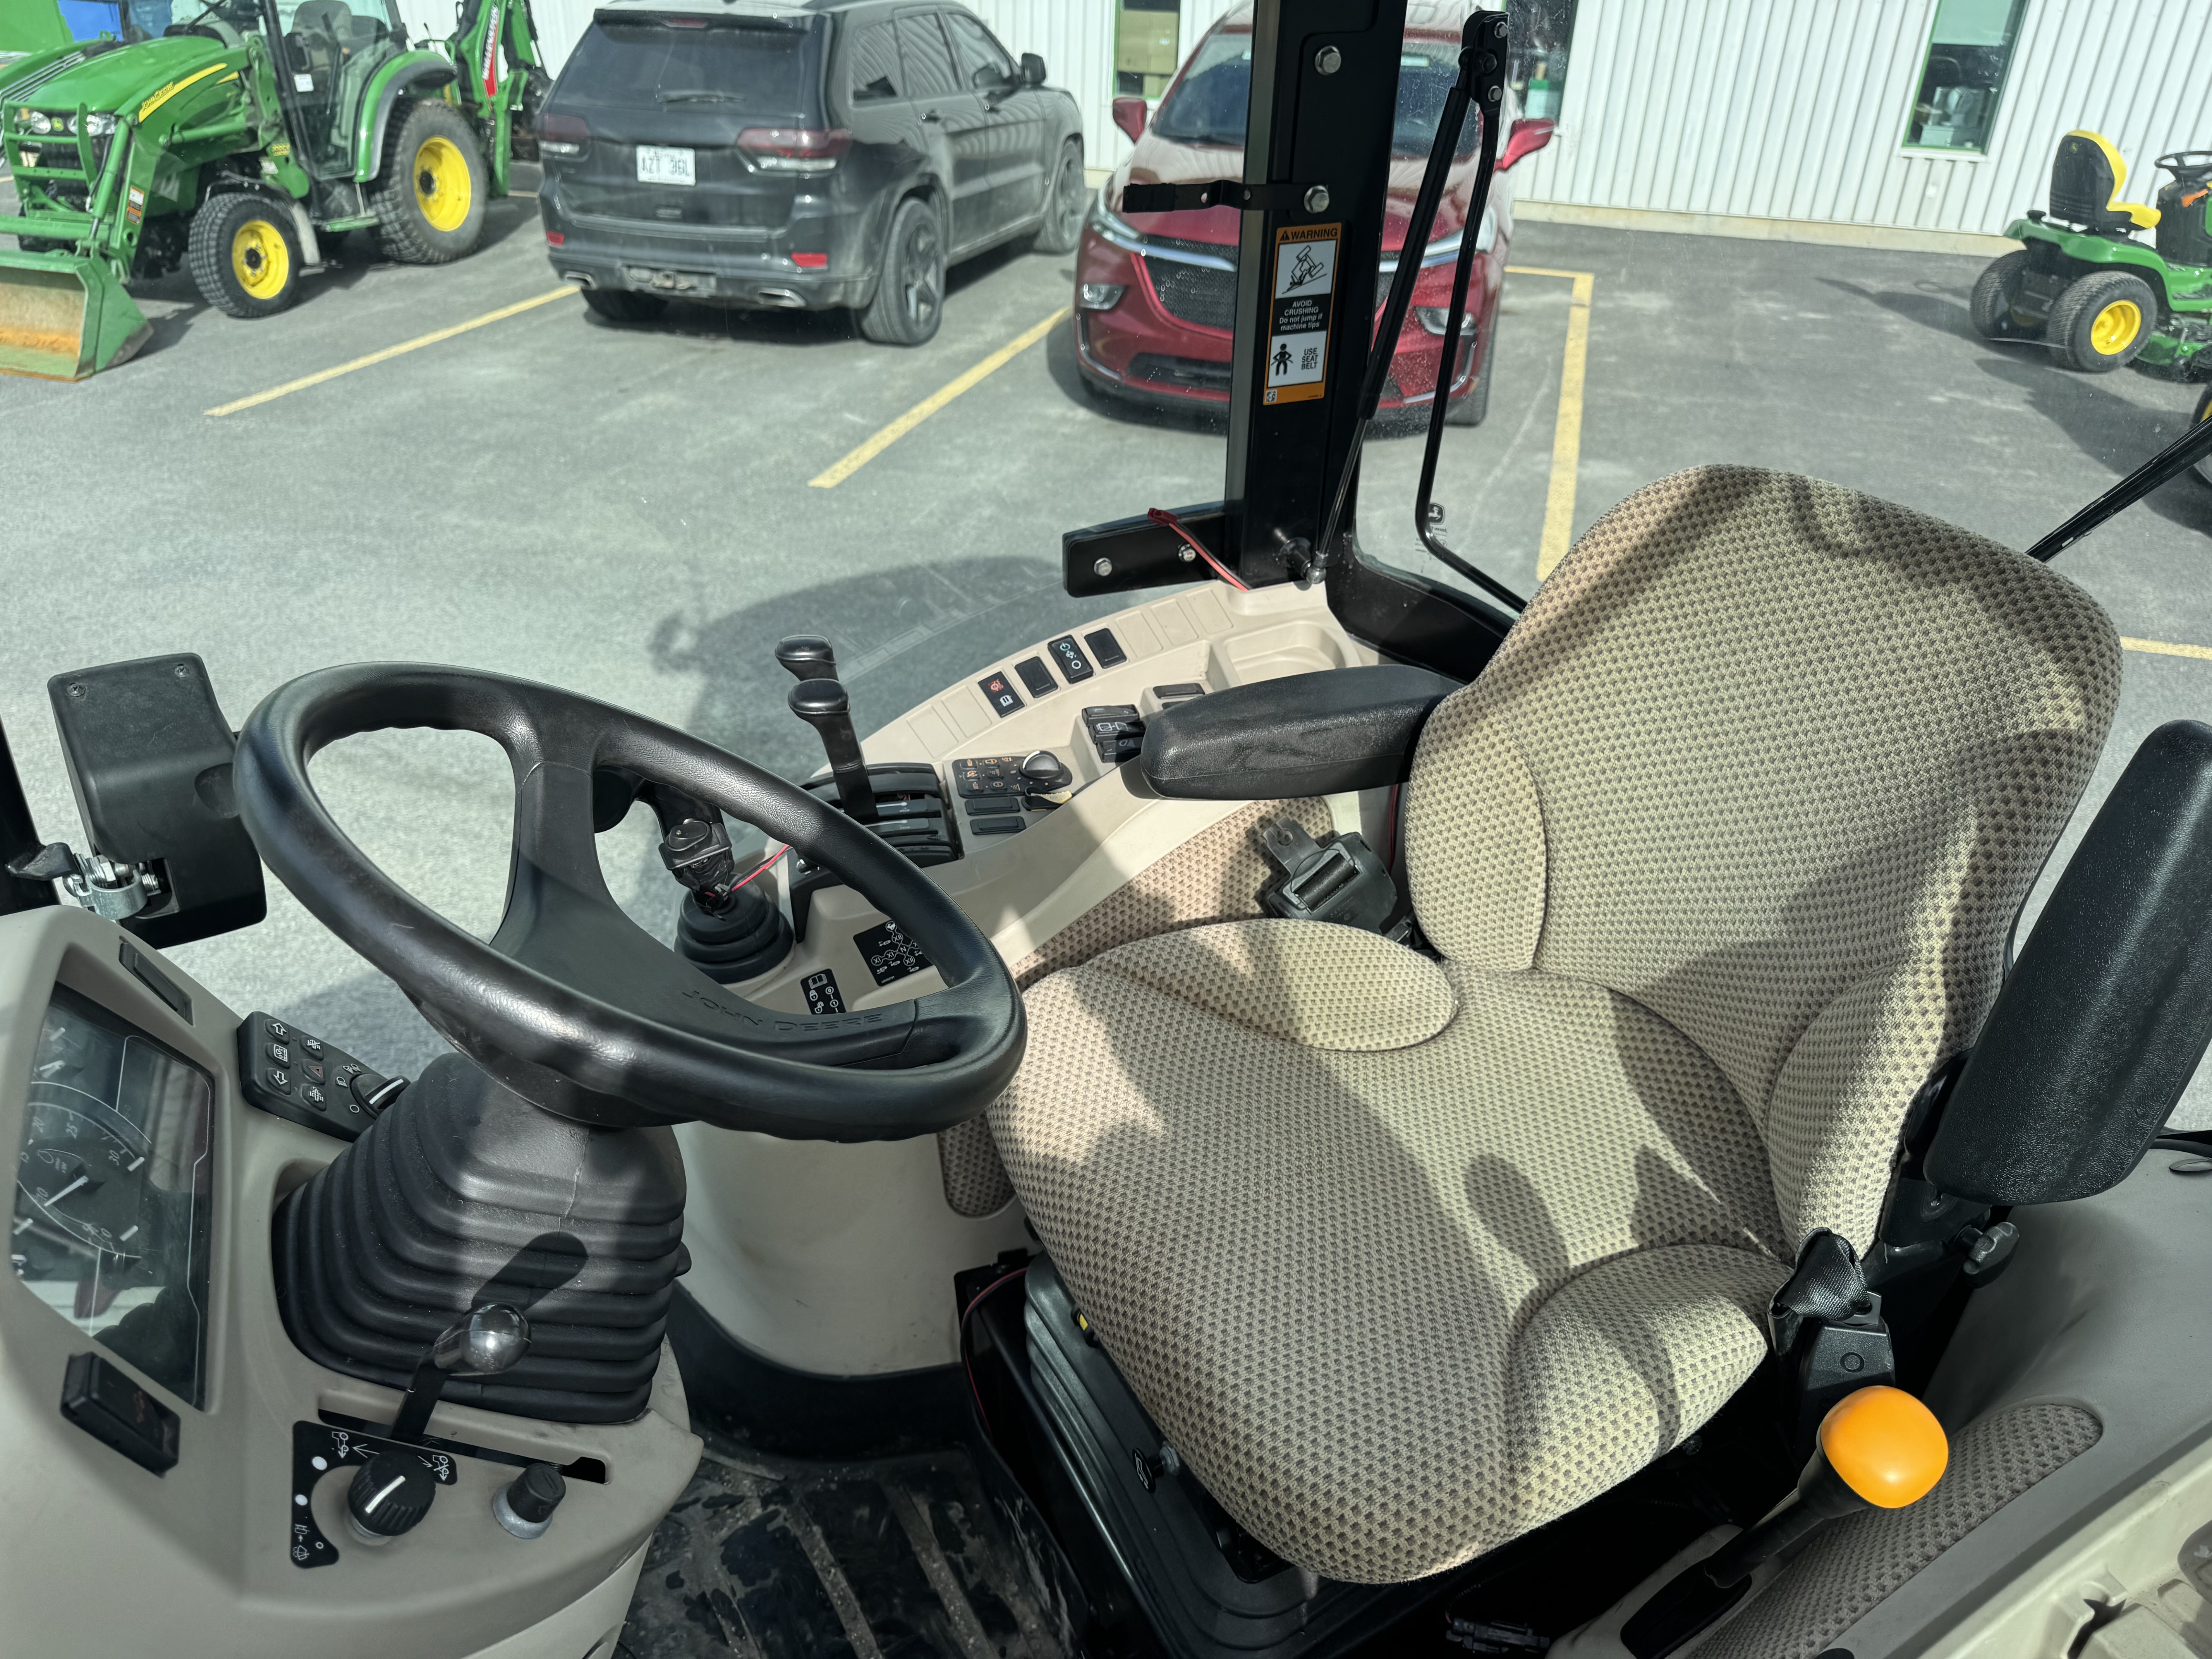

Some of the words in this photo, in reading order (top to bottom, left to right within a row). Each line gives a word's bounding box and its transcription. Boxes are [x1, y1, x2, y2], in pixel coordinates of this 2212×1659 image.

[1291, 228, 1338, 240] WARNING
[1292, 300, 1312, 308] AVOID
[1284, 307, 1319, 316] CRUSHING
[1301, 314, 1317, 323] jump
[1280, 323, 1307, 331] machine
[1308, 320, 1320, 330] tips
[1304, 347, 1317, 356] USE
[1301, 355, 1319, 363] SEAT
[1301, 362, 1318, 370] BELT
[681, 990, 764, 1026] JOHN
[775, 1012, 883, 1032] DEERE
[65, 1122, 78, 1139] 25
[108, 1149, 120, 1166] 30
